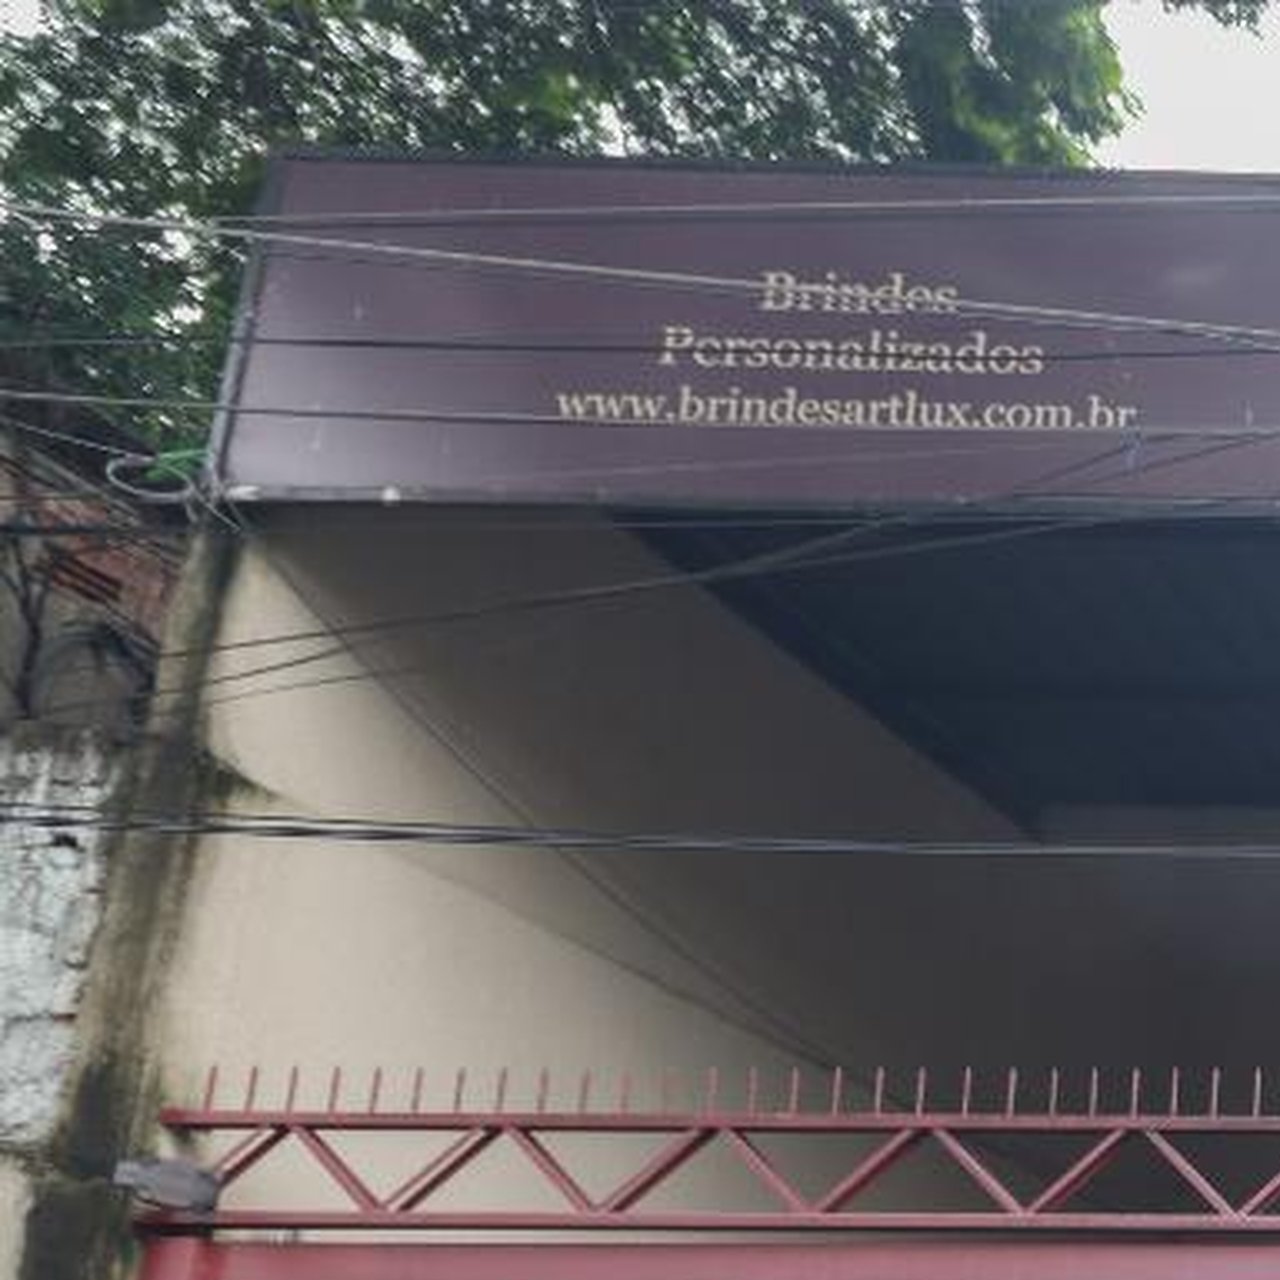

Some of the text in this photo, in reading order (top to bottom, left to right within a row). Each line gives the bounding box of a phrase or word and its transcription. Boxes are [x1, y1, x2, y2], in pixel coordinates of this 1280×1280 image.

[760, 271, 959, 314] Brindes
[658, 326, 1045, 375] Personalizados
[556, 385, 1139, 428] www.brindesartlux.com.br
